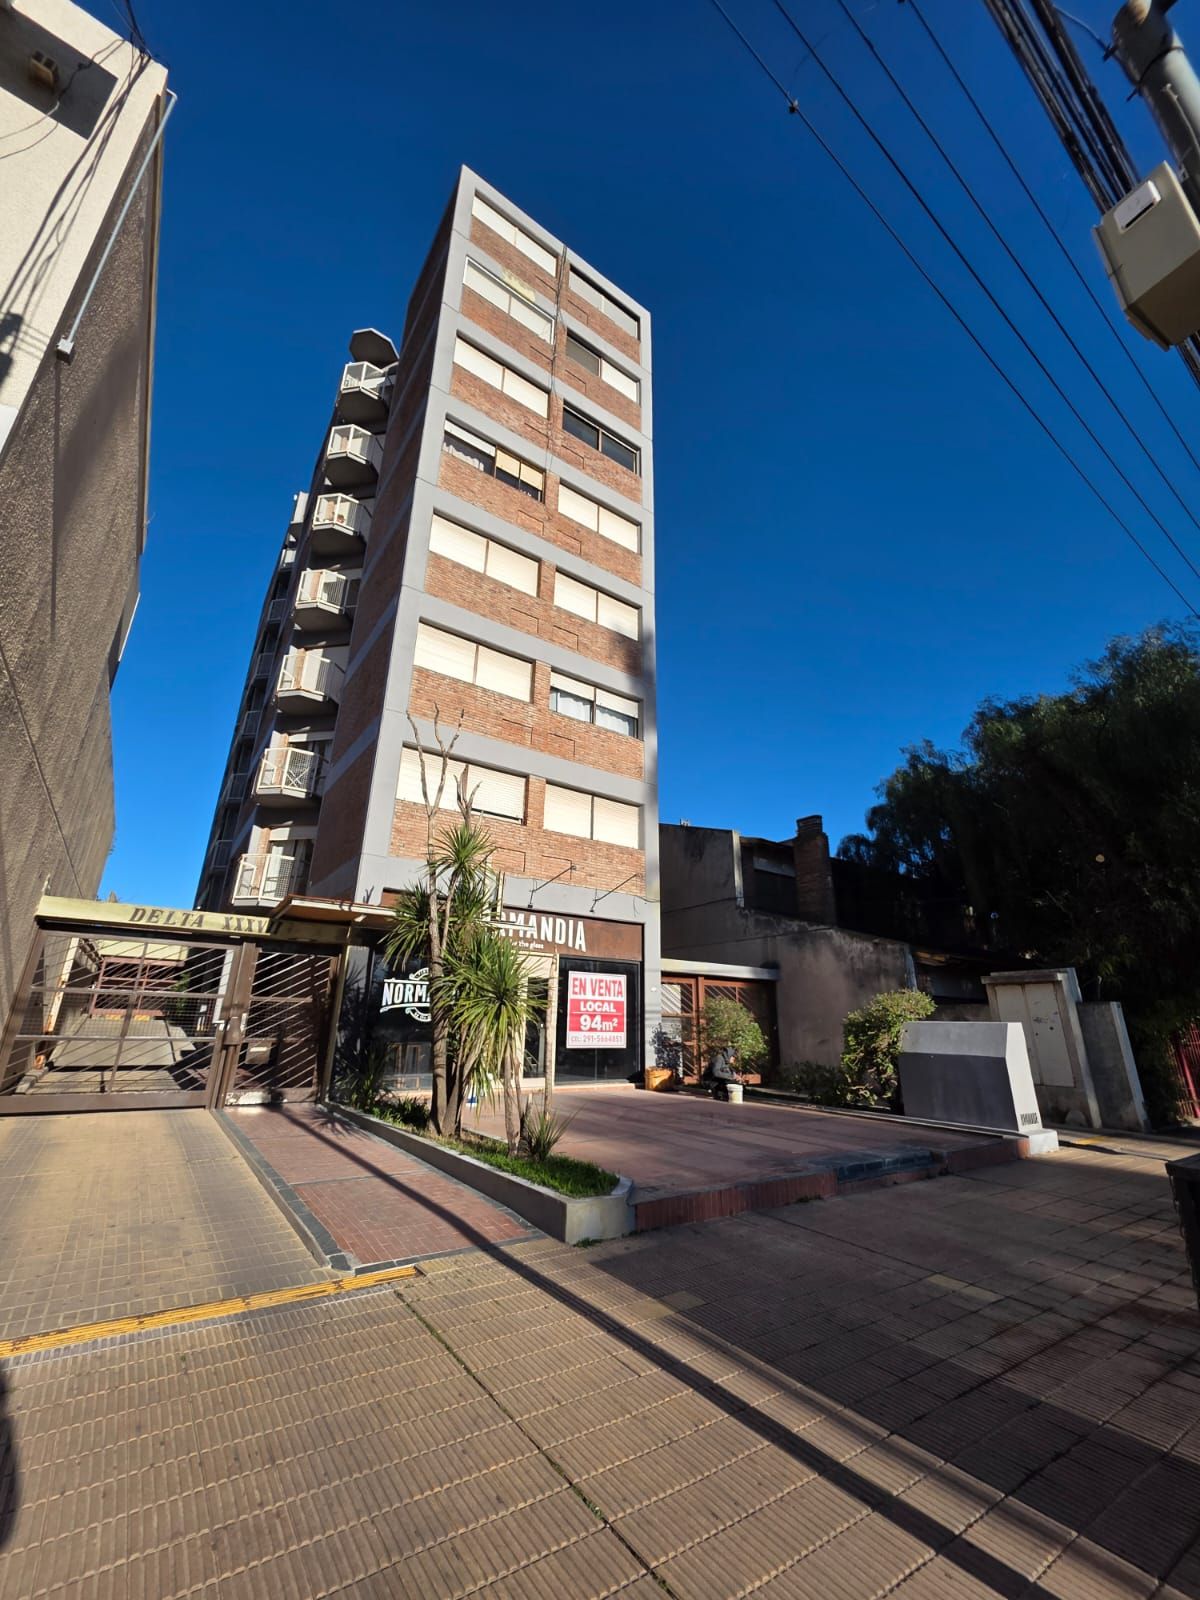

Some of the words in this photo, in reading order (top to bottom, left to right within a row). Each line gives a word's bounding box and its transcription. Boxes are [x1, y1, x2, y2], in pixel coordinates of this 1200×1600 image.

[128, 907, 205, 928] DELTA
[572, 977, 587, 996] EN
[590, 978, 624, 998] VENTA
[580, 1000, 617, 1013] LOCAL
